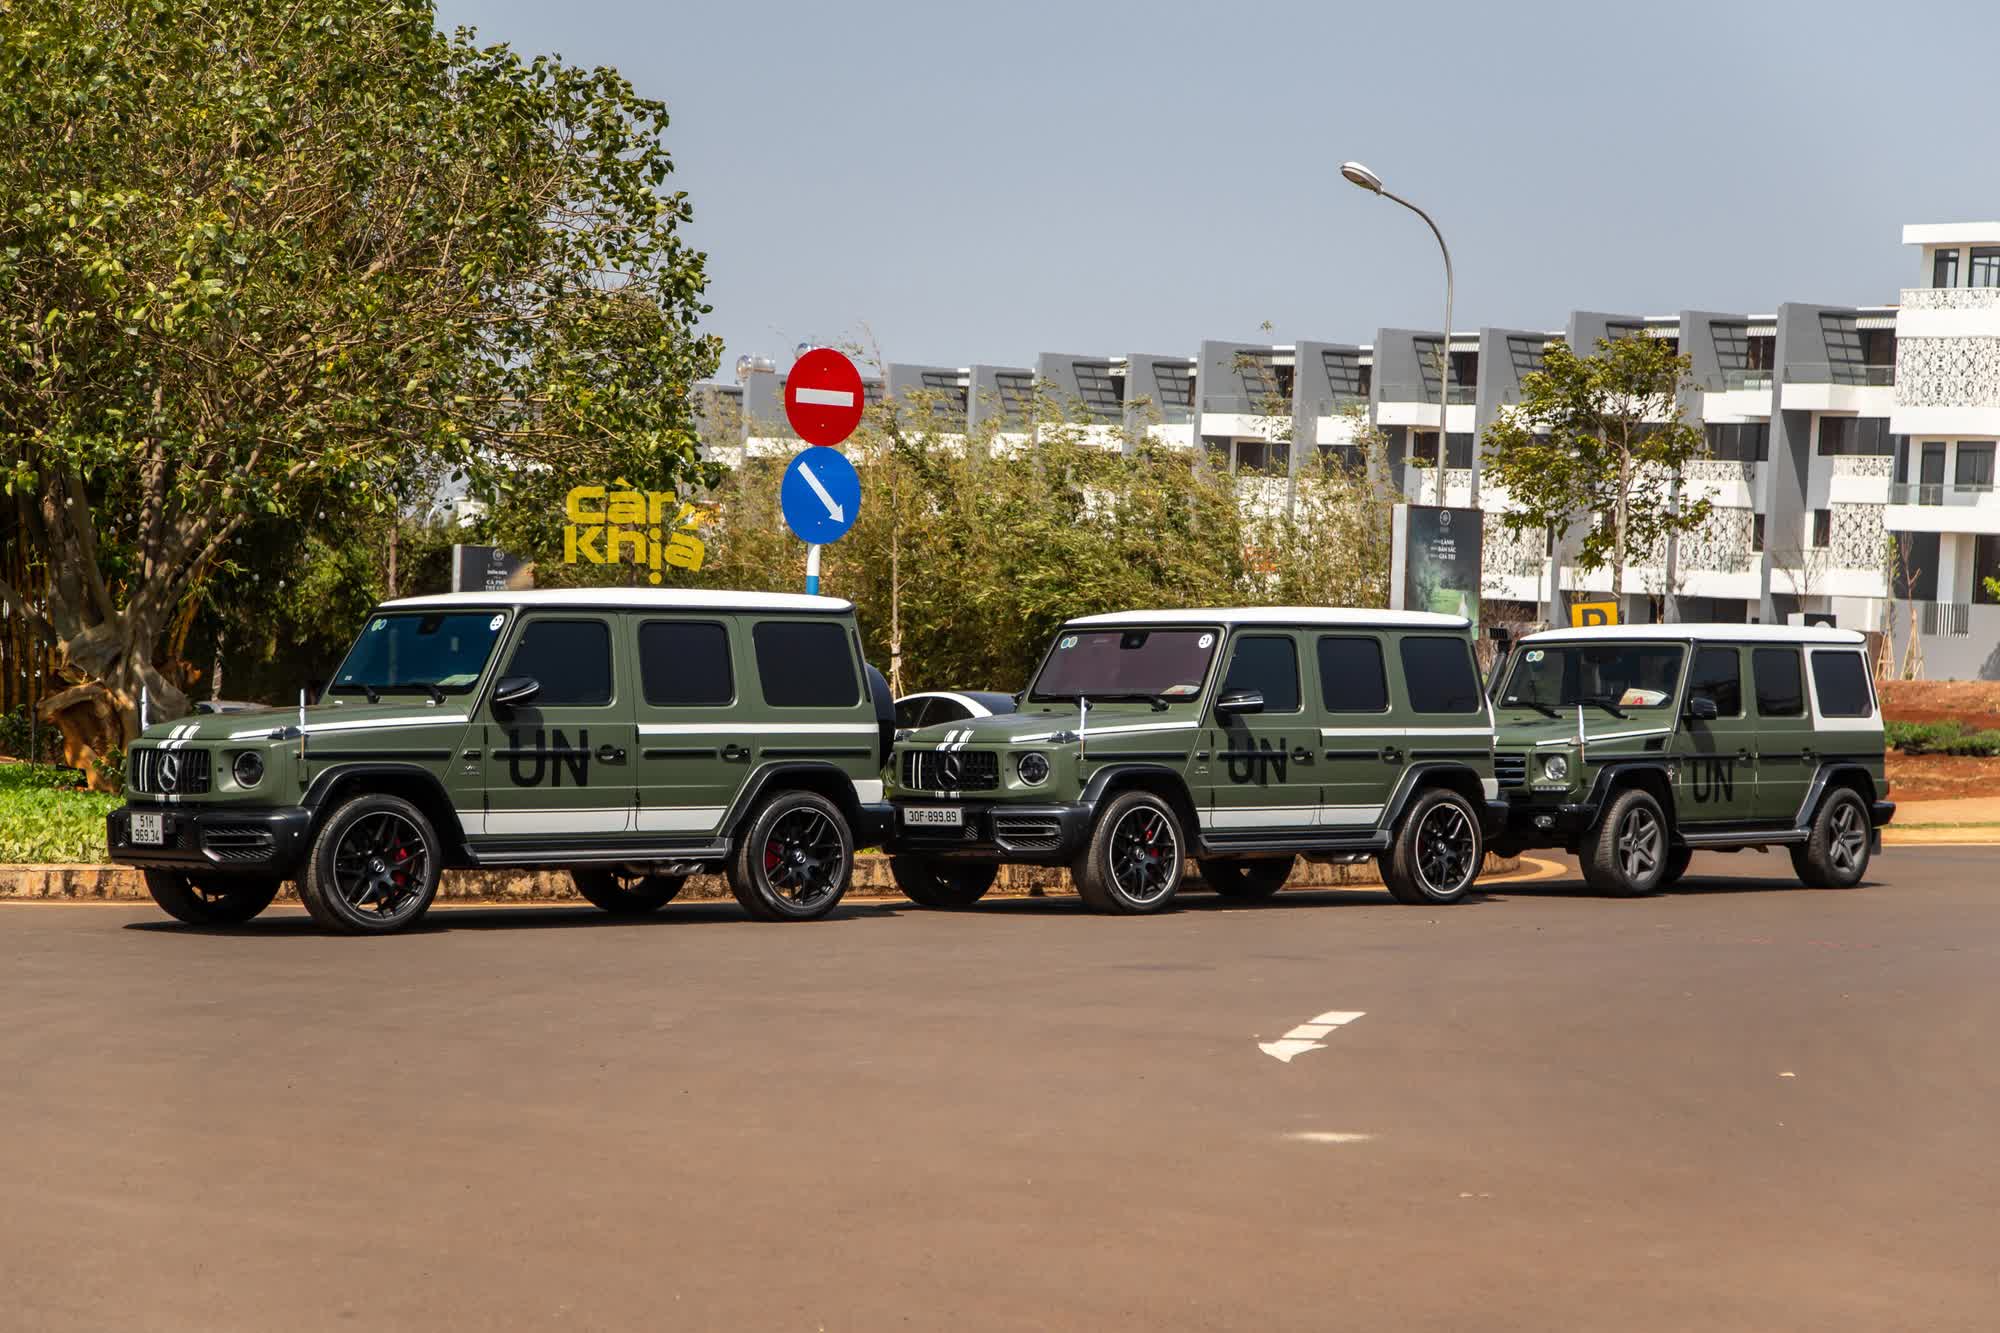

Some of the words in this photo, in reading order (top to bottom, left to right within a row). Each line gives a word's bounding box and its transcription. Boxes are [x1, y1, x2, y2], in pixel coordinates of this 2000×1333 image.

[509, 729, 588, 787] UN
[1228, 737, 1287, 787] UN
[1692, 758, 1733, 803] UN
[909, 810, 957, 823] 30F-899.89
